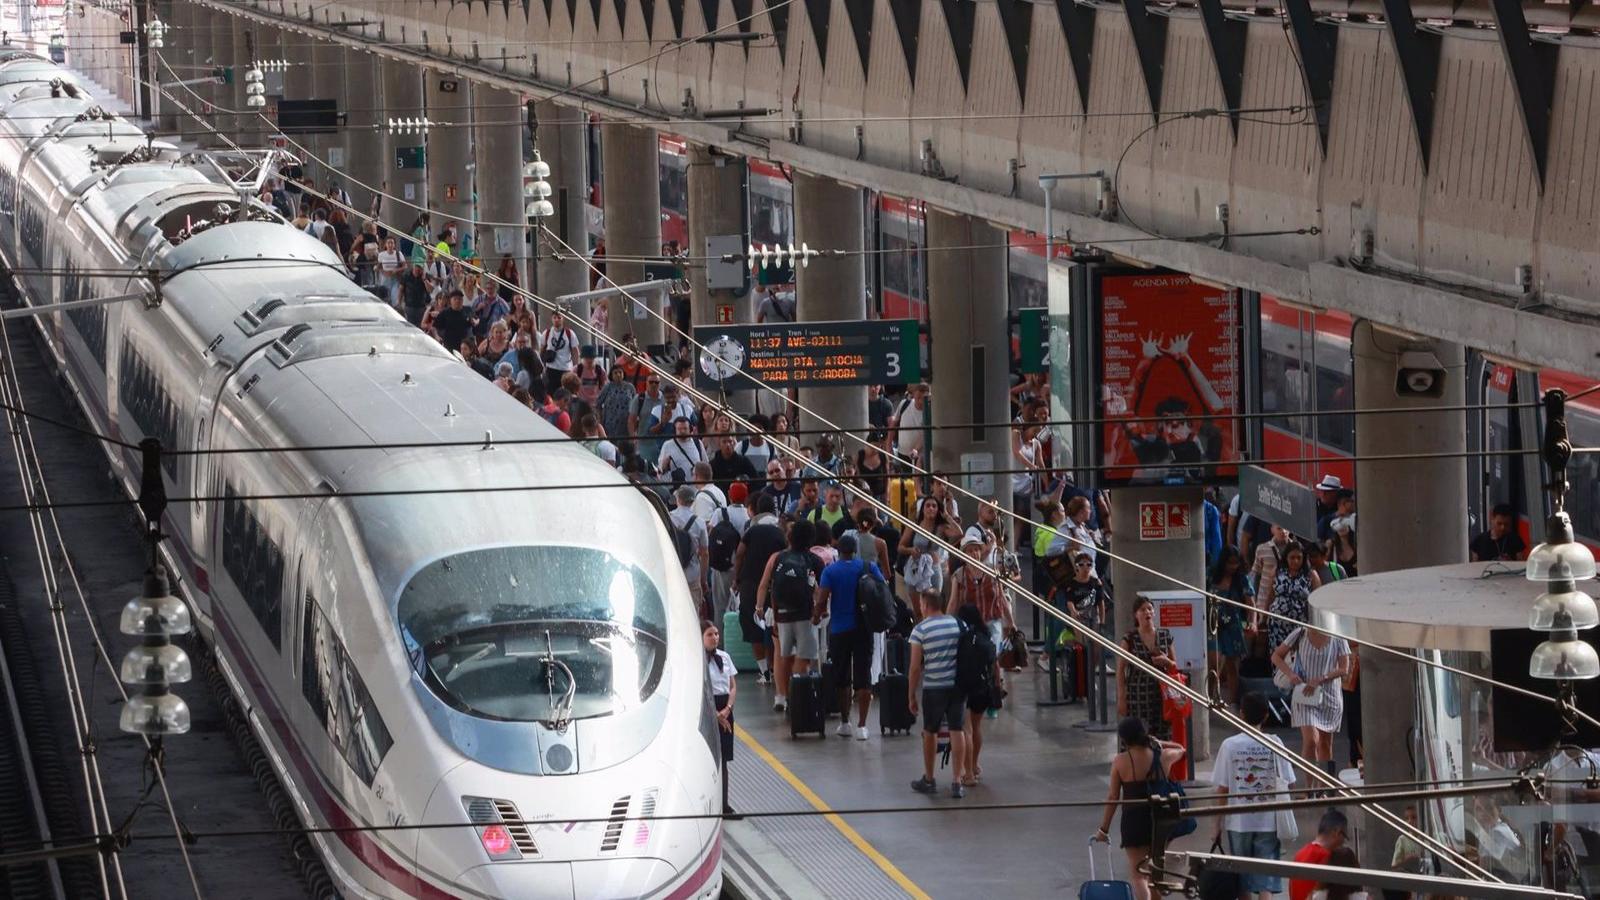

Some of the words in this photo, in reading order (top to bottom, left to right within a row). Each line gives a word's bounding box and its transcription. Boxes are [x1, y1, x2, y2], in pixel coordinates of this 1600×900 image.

[398, 157, 404, 168] 3
[1133, 278, 1168, 288] AGENDA
[750, 338, 781, 349] 11:37
[787, 336, 842, 348] AVE-02111
[750, 357, 788, 369] MADRID
[825, 354, 863, 366] ATOCHA
[886, 352, 901, 377] 3
[762, 370, 788, 381] PARA
[793, 369, 807, 380] EN
